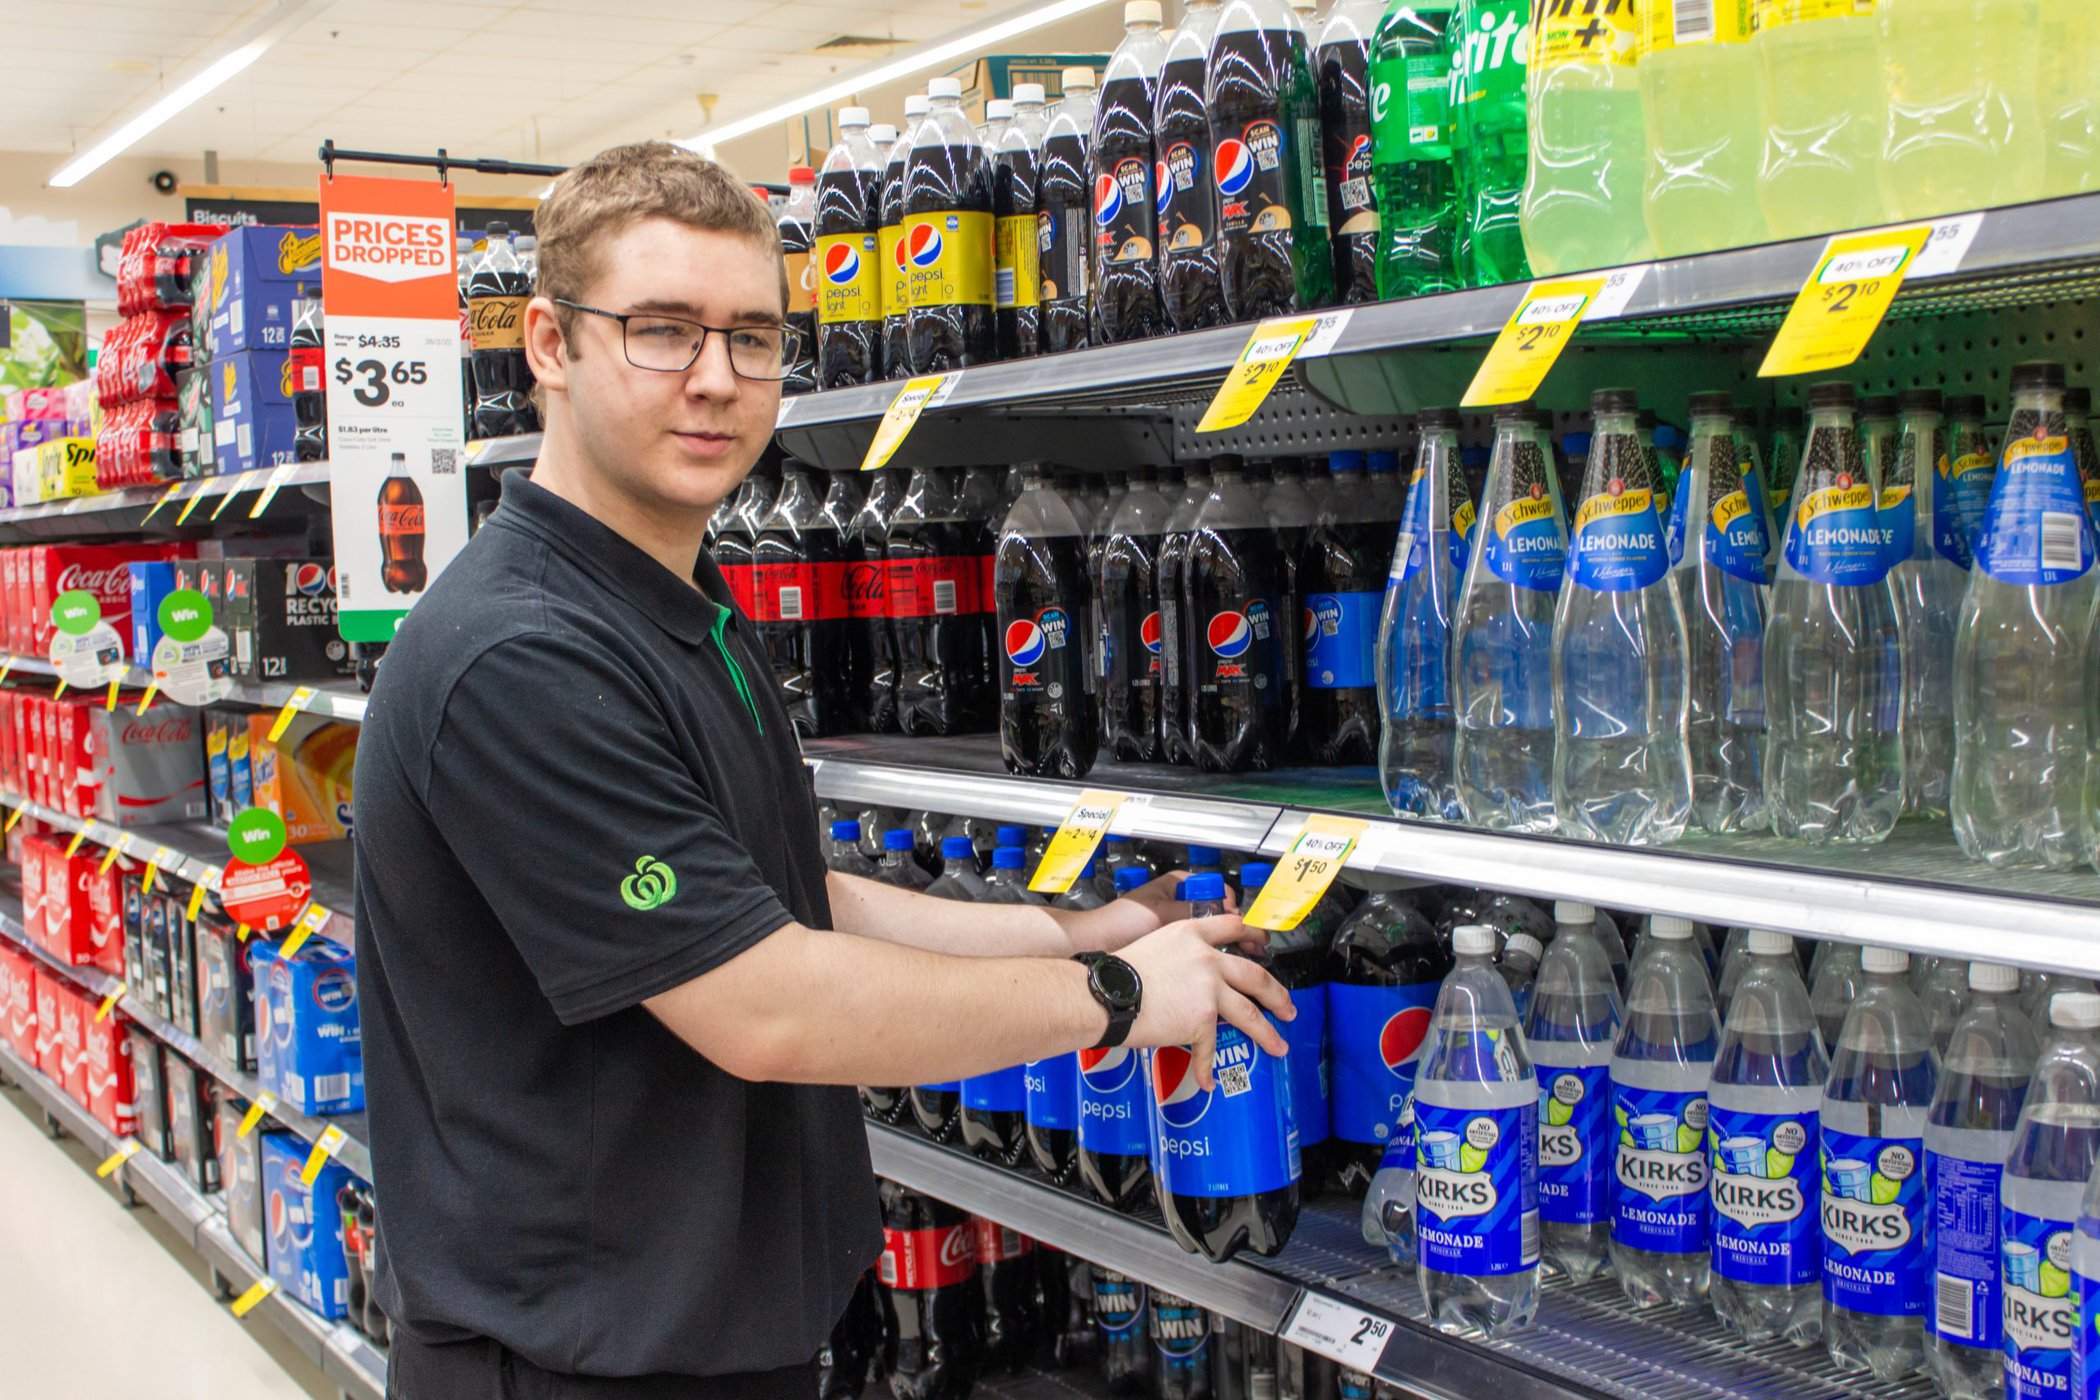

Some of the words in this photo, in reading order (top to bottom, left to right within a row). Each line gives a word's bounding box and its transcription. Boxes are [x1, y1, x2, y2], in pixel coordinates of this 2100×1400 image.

[1249, 135, 1279, 152] WIN
[1170, 157, 1194, 174] WIN
[1118, 172, 1145, 187] WIN
[193, 209, 258, 225] Biscuits
[334, 219, 445, 248] PRICES
[334, 245, 446, 267] DROPPED
[1867, 255, 1901, 269] OFF
[910, 268, 943, 285] pepsi
[826, 286, 861, 301] pepsi
[826, 300, 846, 313] light
[1553, 302, 1581, 314] OFF
[358, 334, 401, 349] $4.35
[1275, 341, 1295, 353] OFF
[391, 400, 405, 408] ea
[373, 426, 388, 434] litre
[2011, 462, 2065, 476] LEMONADE
[1580, 533, 1656, 551] LEMONADE
[1807, 528, 1882, 546] LEMONADE
[64, 607, 88, 619] Win
[172, 609, 199, 622] Win
[286, 615, 328, 626] PLASTIC
[1248, 610, 1270, 625] WIN
[1317, 607, 1338, 621] WIN
[1041, 619, 1067, 634] WIN
[1078, 808, 1109, 822] Special
[242, 829, 271, 844] Win
[288, 824, 308, 840] 30
[1324, 840, 1346, 851] OFF
[321, 991, 342, 1003] WIN
[317, 1024, 344, 1039] WIN
[1082, 1099, 1132, 1121] pepsi
[1478, 1123, 1490, 1131] NO
[1785, 1127, 1798, 1135] NO
[1160, 1136, 1210, 1160] pepsi
[1891, 1151, 1905, 1160] NO
[1620, 1154, 1703, 1184] KIRKS
[1418, 1171, 1489, 1205] KIRKS
[1714, 1178, 1796, 1211] KIRKS
[1621, 1205, 1697, 1226] LEMONADE
[1822, 1200, 1901, 1239] KIRKS
[1418, 1224, 1484, 1249] LEMONADE
[1716, 1232, 1790, 1255] LEMONADE
[1824, 1256, 1896, 1285] LEMONADE
[1098, 1293, 1137, 1313] WIN
[1160, 1318, 1203, 1339] WIN
